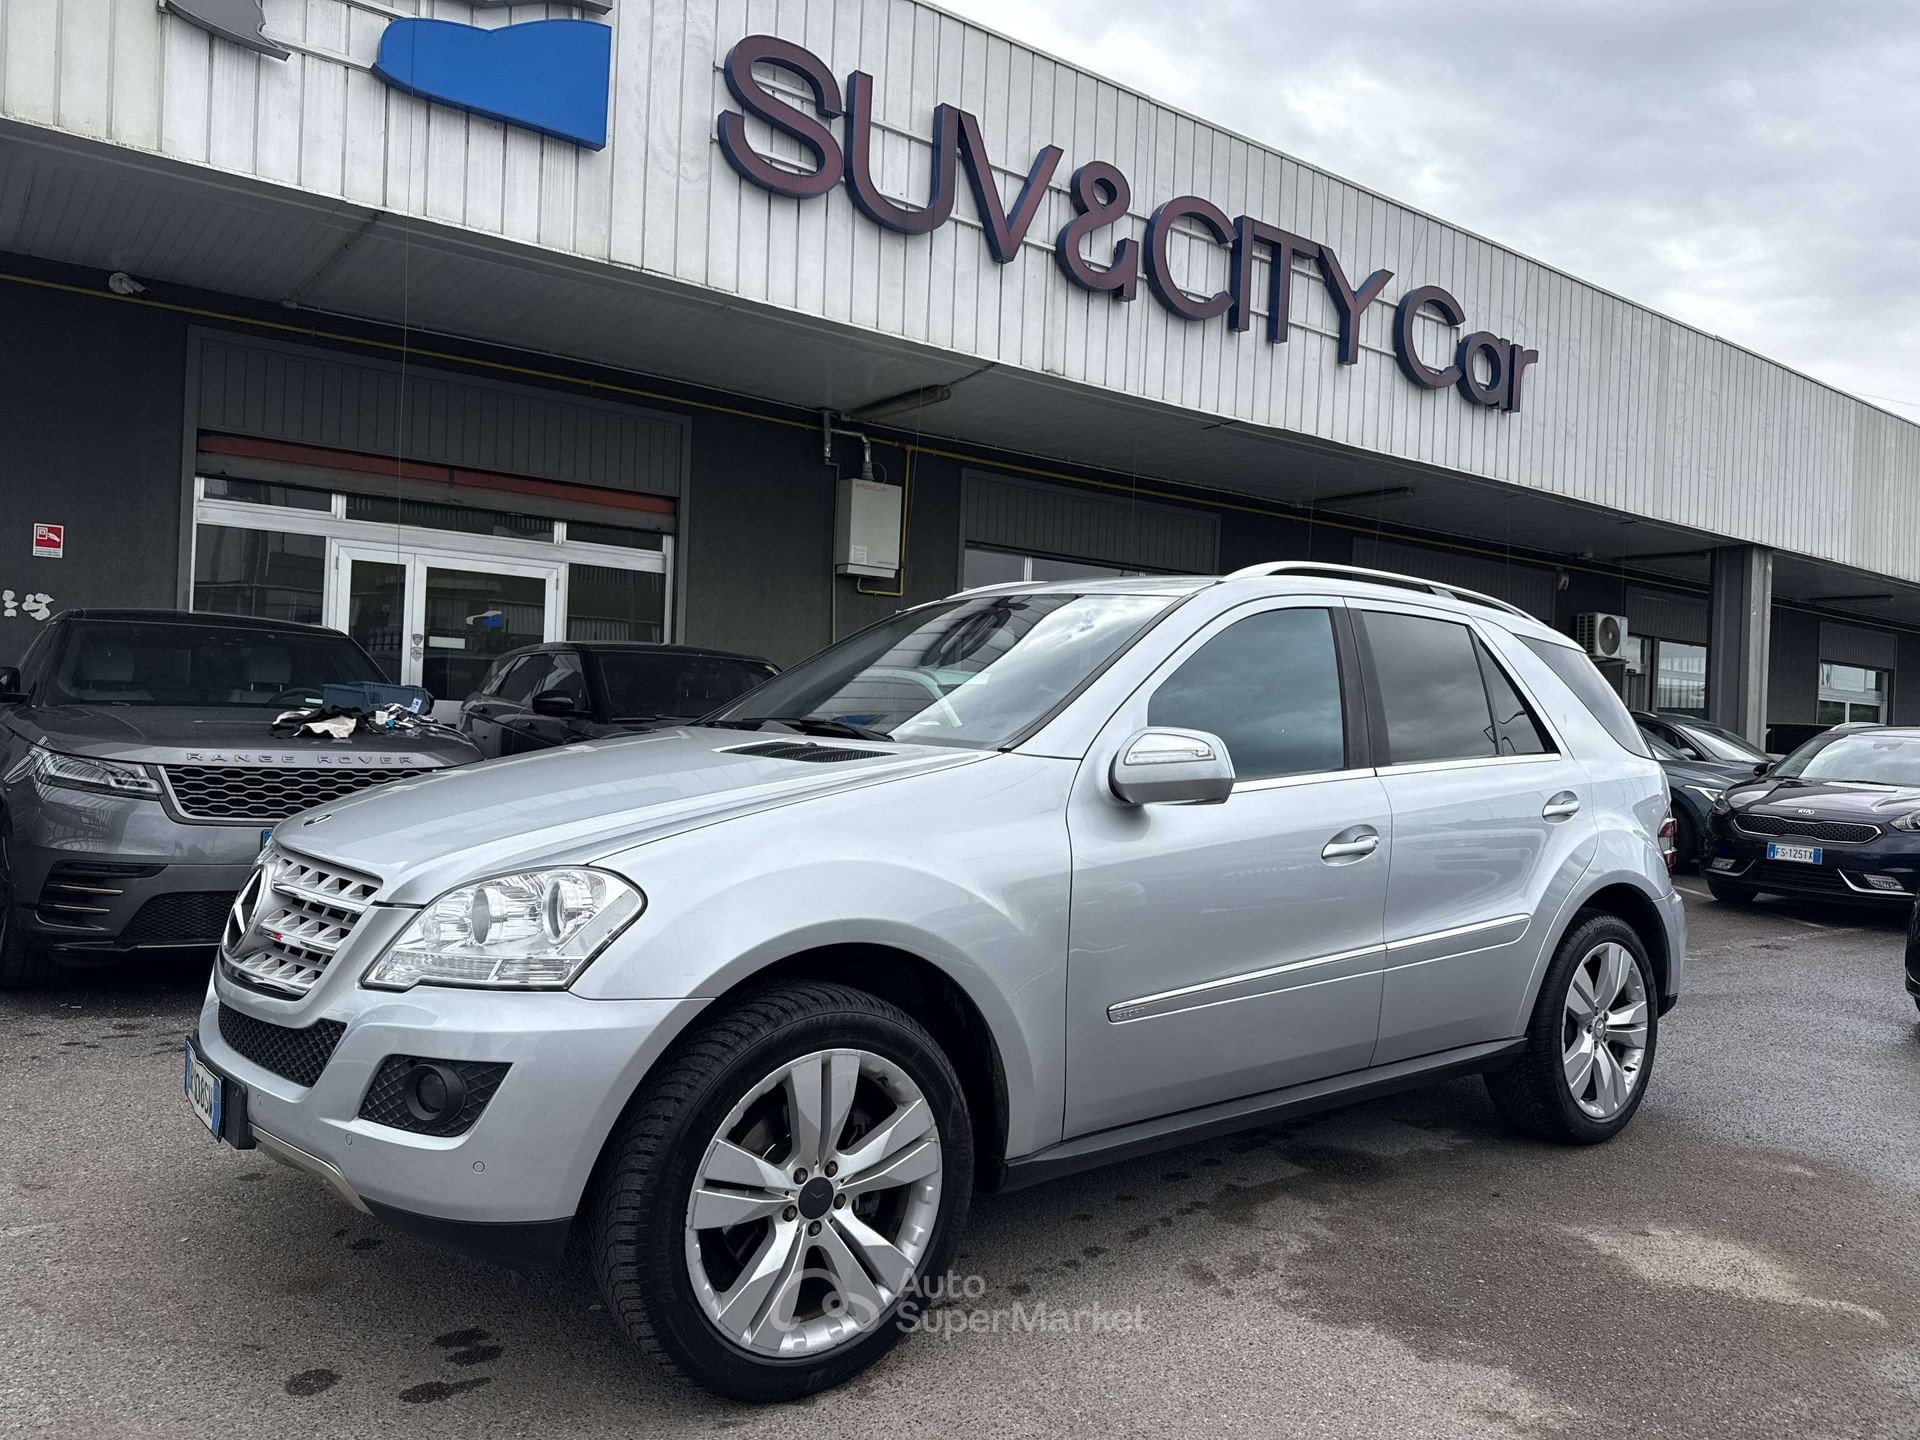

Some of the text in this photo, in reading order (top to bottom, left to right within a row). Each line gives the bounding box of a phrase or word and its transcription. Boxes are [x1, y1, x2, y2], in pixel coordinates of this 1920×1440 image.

[1395, 285, 1538, 414] Car
[186, 752, 414, 766] RANGE ROVER
